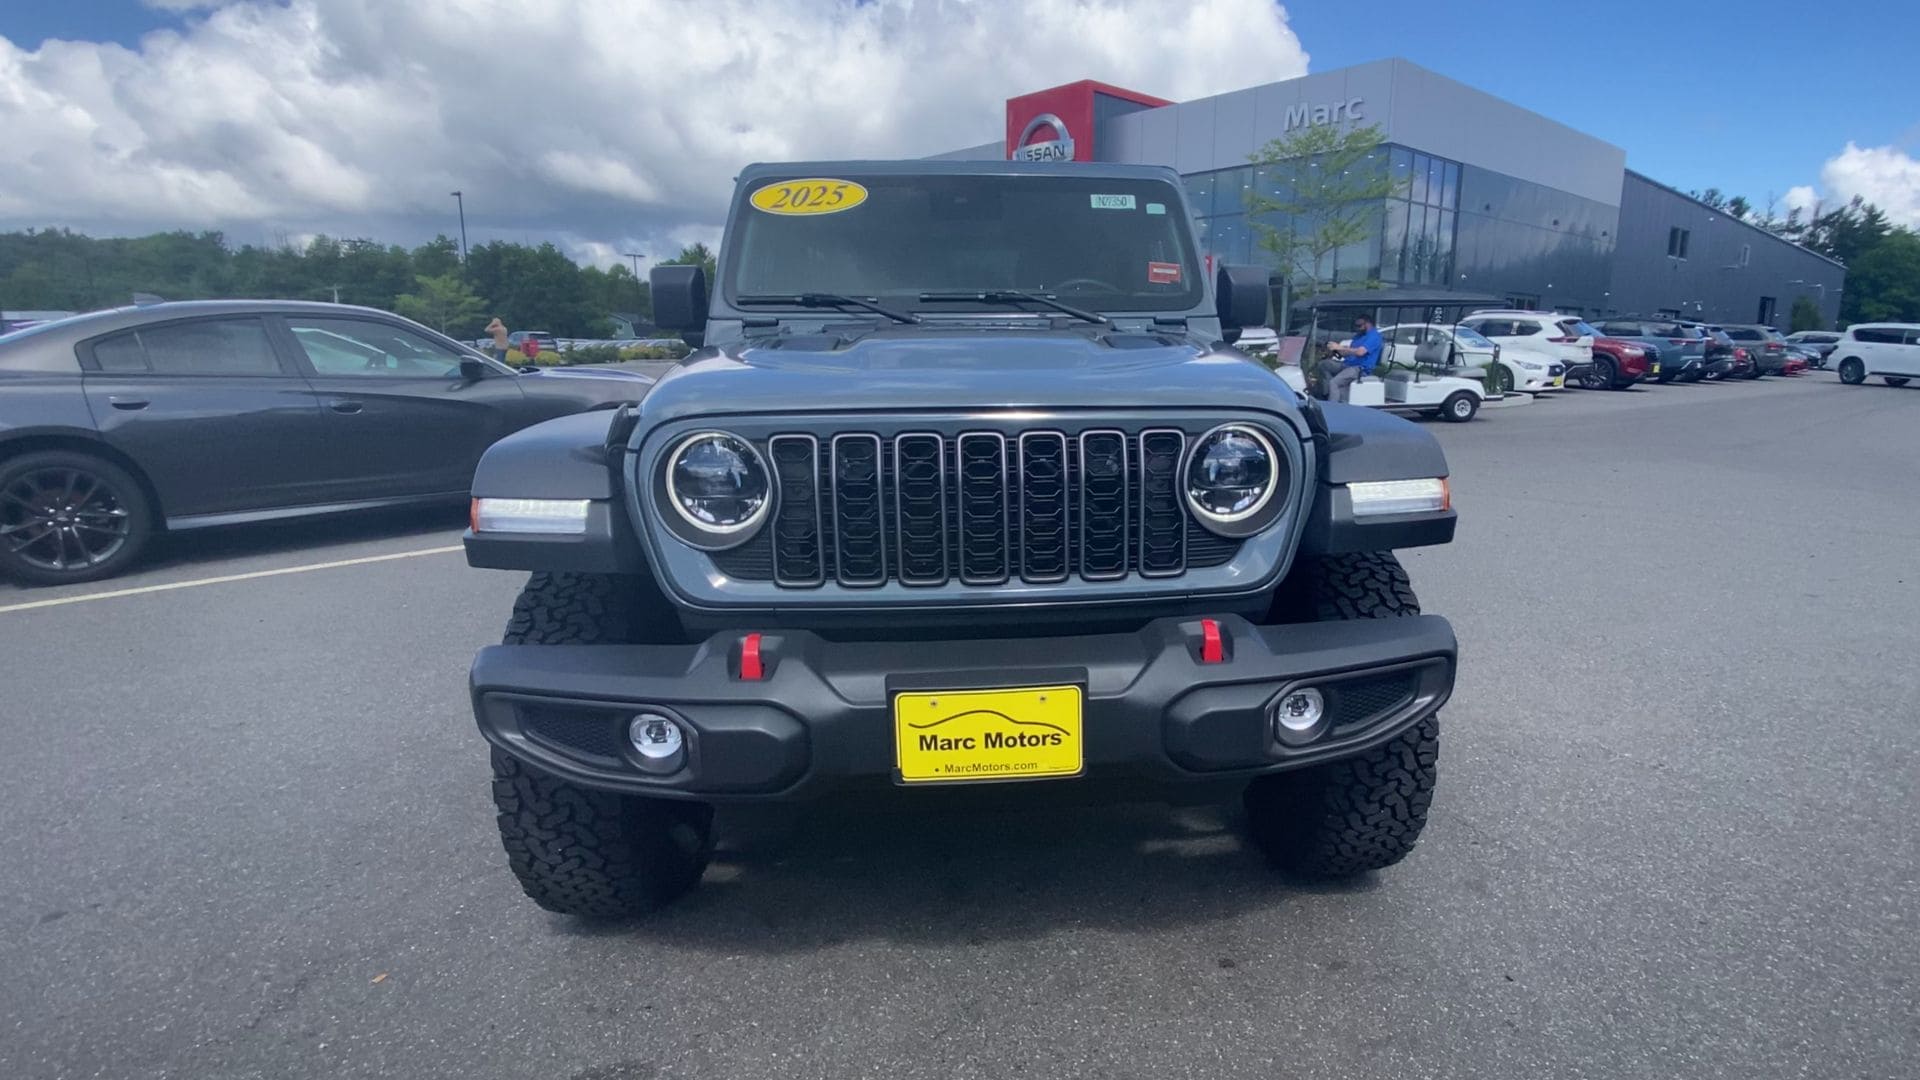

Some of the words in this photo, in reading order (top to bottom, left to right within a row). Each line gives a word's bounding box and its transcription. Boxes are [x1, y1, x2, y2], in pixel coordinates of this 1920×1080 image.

[1284, 96, 1364, 132] Marc
[769, 184, 849, 209] 2025
[919, 735, 976, 751] Marc
[984, 732, 1062, 749] Motors
